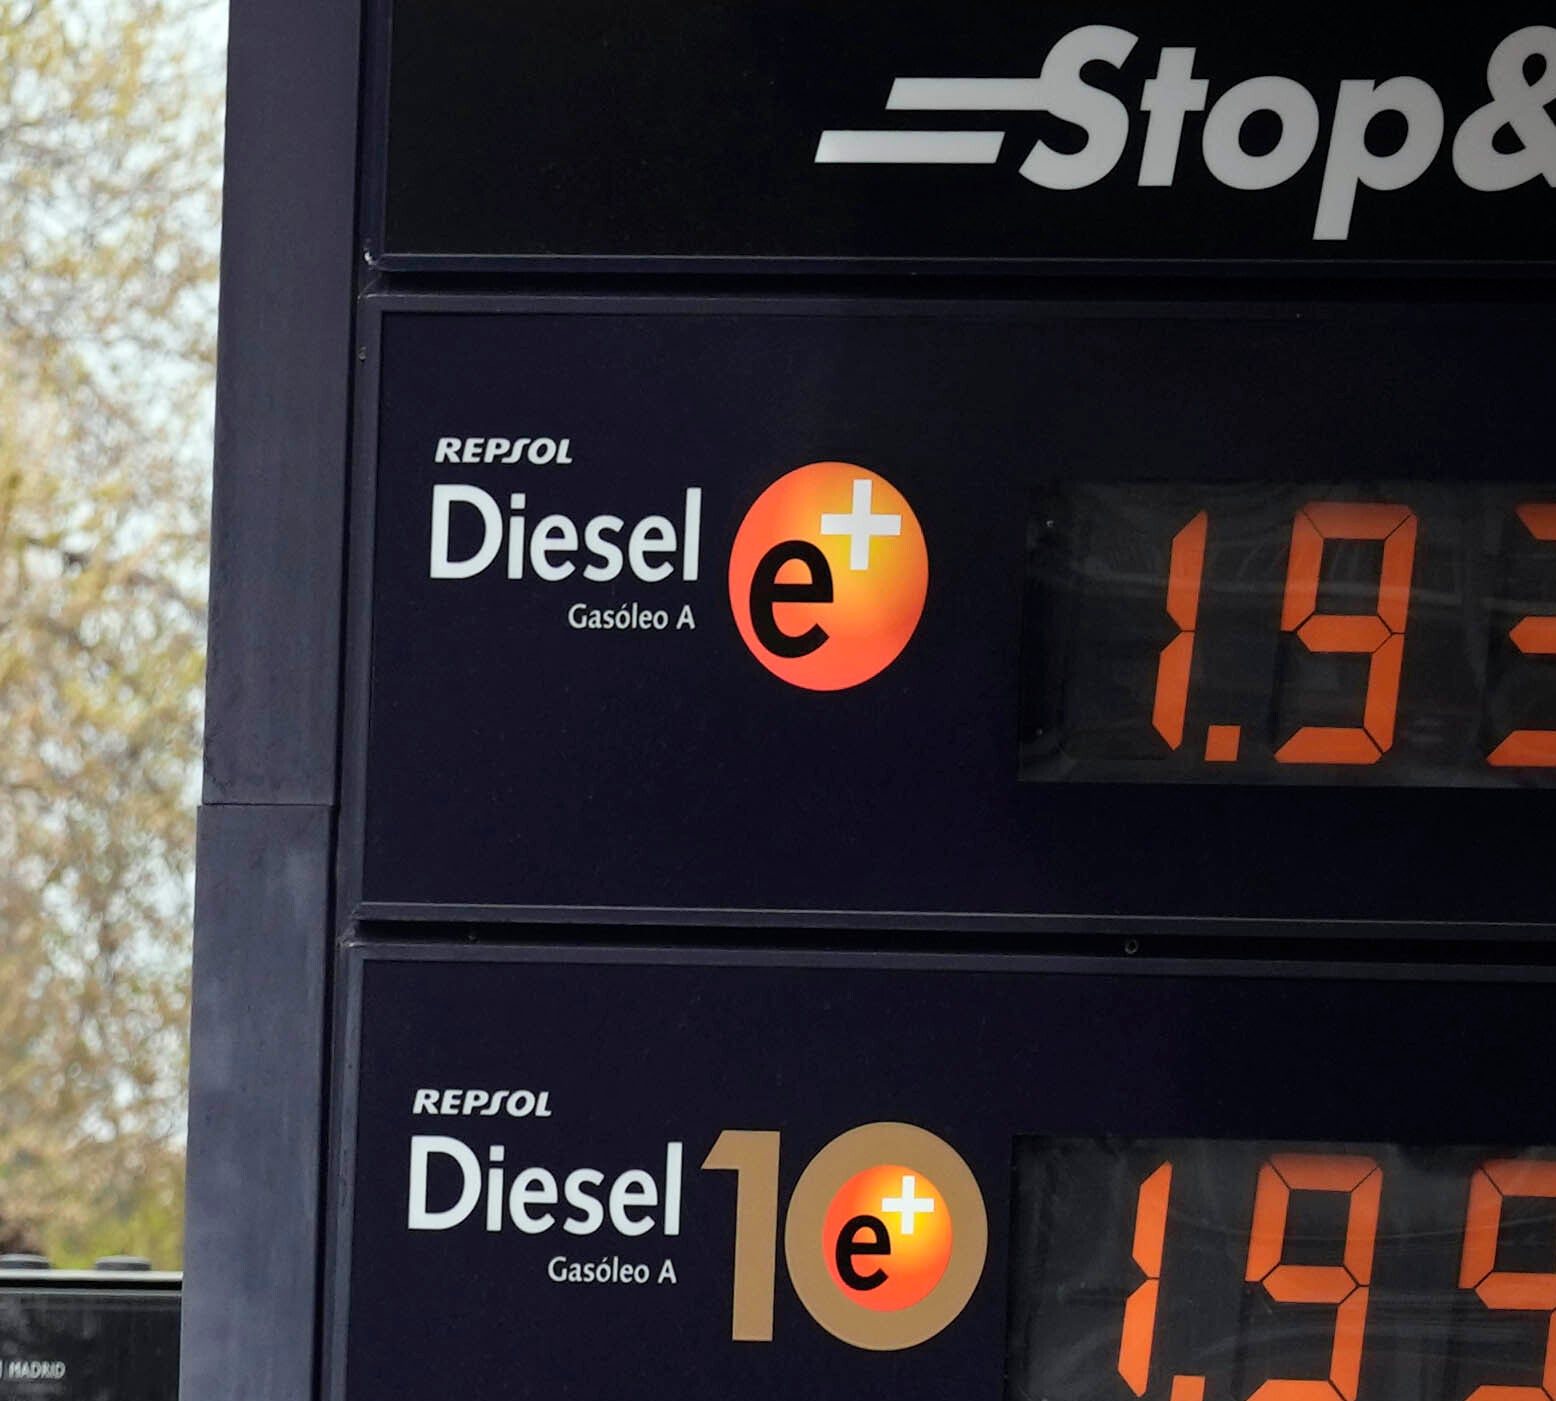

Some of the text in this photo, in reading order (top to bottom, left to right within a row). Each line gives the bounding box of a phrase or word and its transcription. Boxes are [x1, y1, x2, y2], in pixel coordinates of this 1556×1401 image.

[434, 437, 573, 465] REPSOL
[430, 484, 702, 582] Diesel
[568, 603, 696, 630] Gasóleo A
[412, 1088, 552, 1117] REPSOL
[408, 1121, 988, 1351] Diesel 10
[547, 1255, 677, 1284] Gasóleo A
